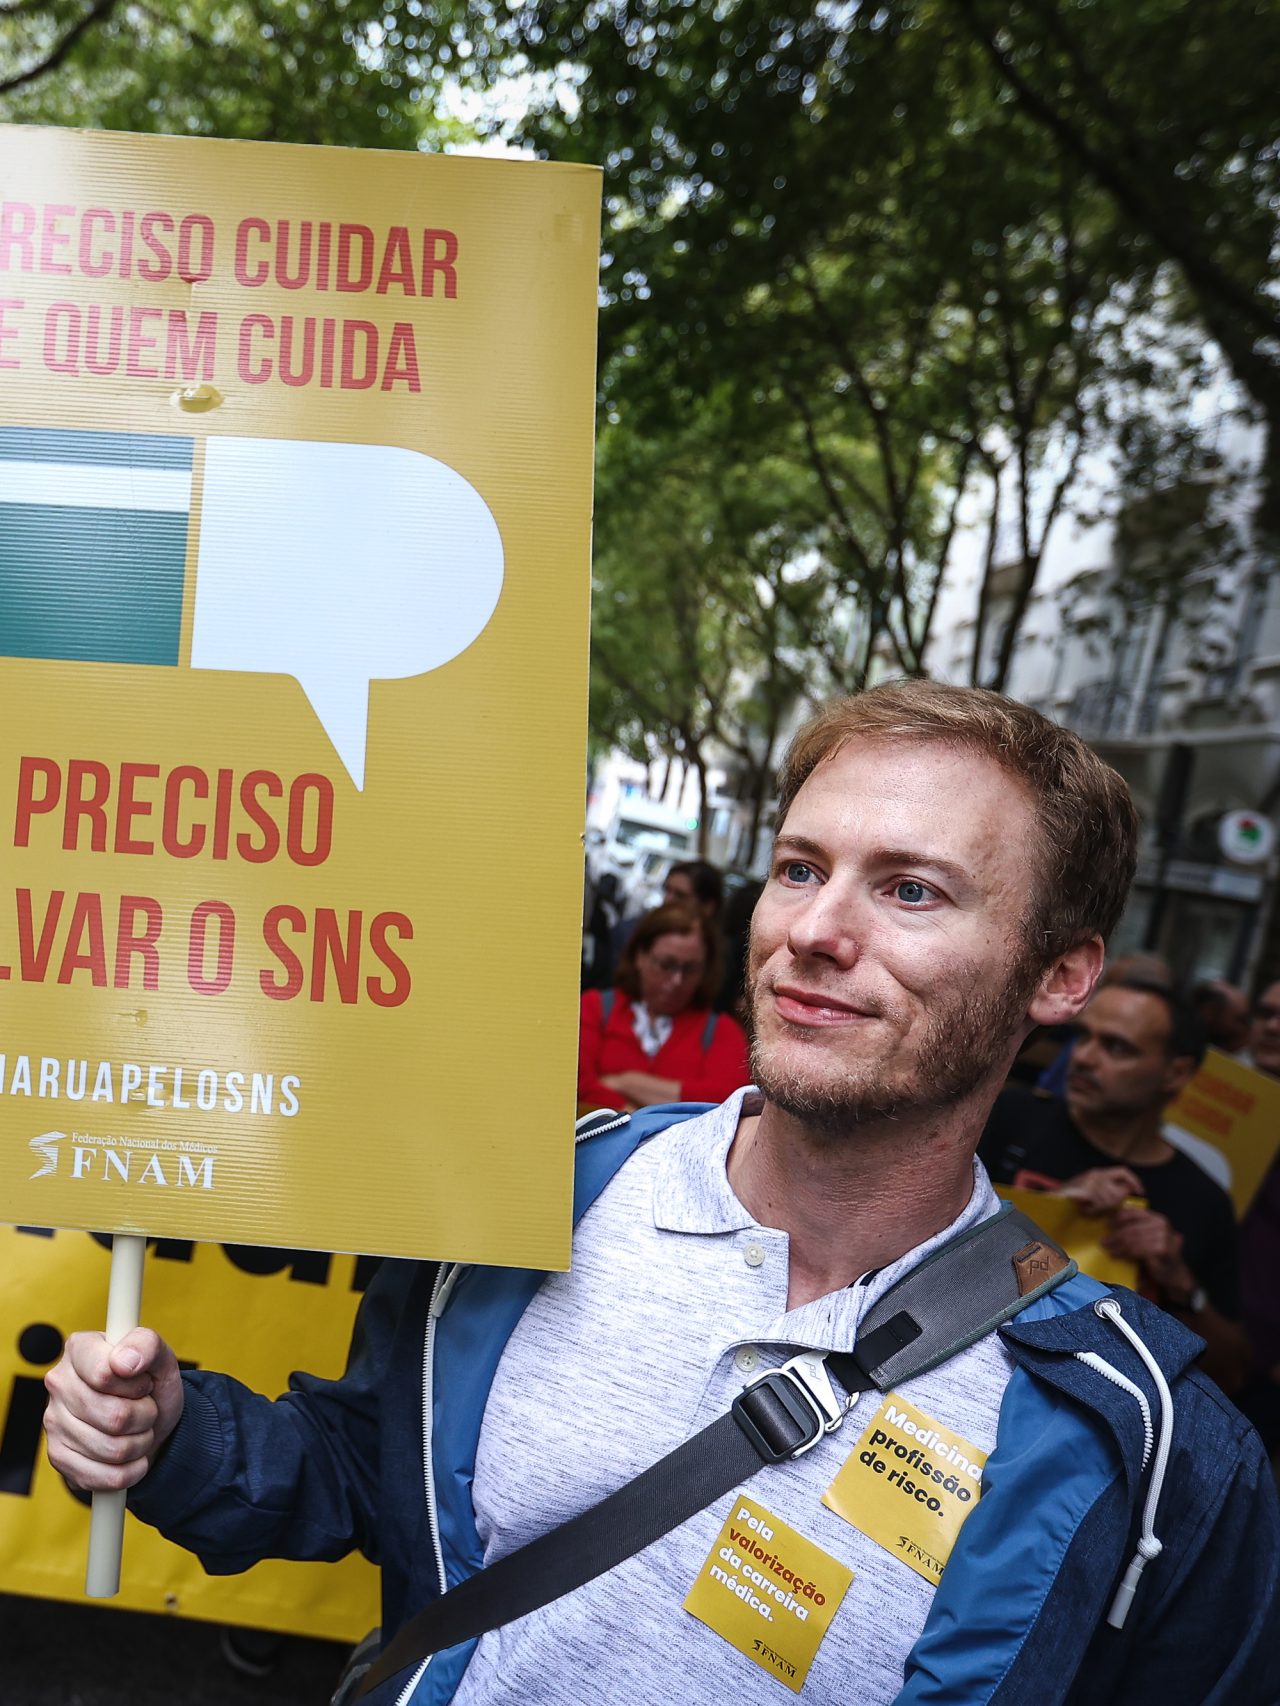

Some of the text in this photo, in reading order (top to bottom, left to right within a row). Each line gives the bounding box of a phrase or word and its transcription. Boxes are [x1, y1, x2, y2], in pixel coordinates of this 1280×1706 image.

[234, 217, 459, 299] CUIDAR
[43, 301, 218, 381] QUEM
[238, 313, 422, 394] CUIDA
[14, 755, 335, 867] PRECISO
[187, 900, 236, 996] O
[259, 903, 414, 1008] SNS
[69, 1146, 219, 1190] FNAM
[71, 1131, 219, 1154] Federação Nacional dos Médicos
[859, 1450, 944, 1517] de risco.
[868, 1428, 972, 1502] profissão
[736, 1507, 774, 1542] Pela
[709, 1564, 773, 1622] médica.
[719, 1547, 809, 1621] da carreira
[729, 1527, 826, 1606] valorização
[907, 1544, 945, 1576] FNAM
[761, 1648, 797, 1678] FNAM
